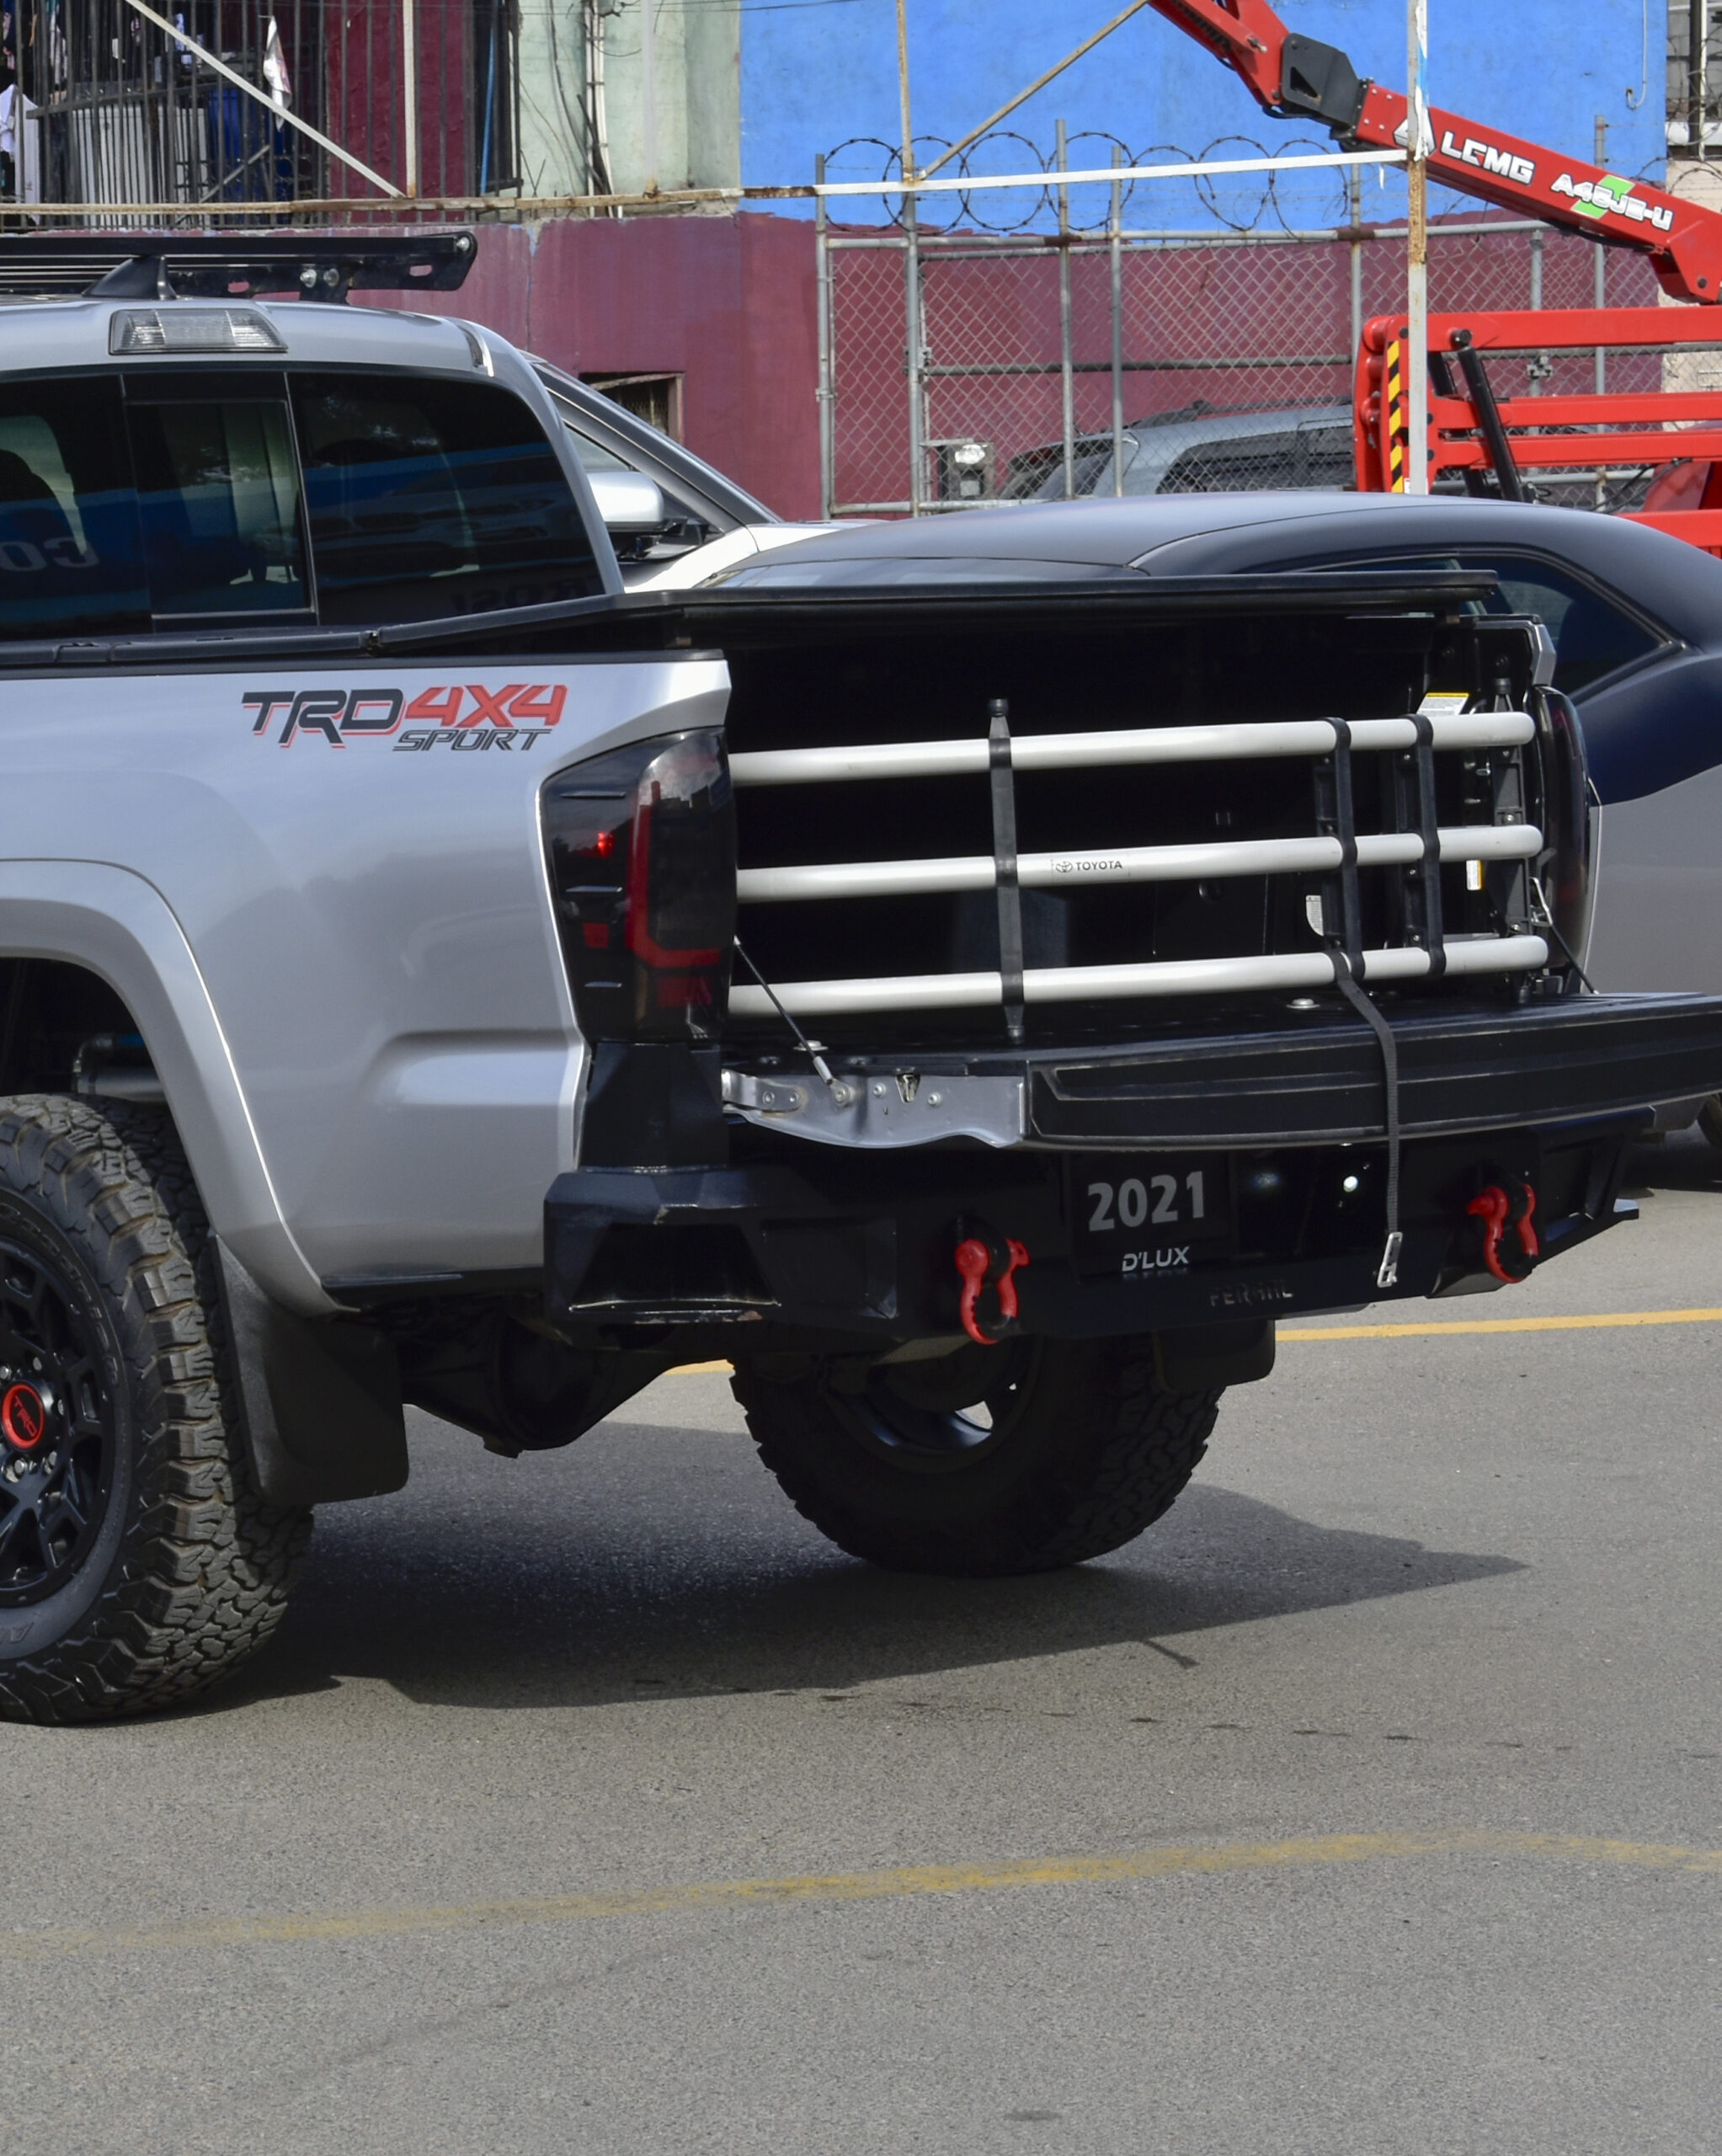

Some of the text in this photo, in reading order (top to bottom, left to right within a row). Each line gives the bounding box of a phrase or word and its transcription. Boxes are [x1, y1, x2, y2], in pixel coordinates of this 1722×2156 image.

[241, 684, 568, 749] TRD 4X4
[392, 728, 552, 751] SPORT
[1075, 861, 1122, 871] TOYOTA
[1087, 1171, 1205, 1232] 2021
[13, 1394, 39, 1438] TRD
